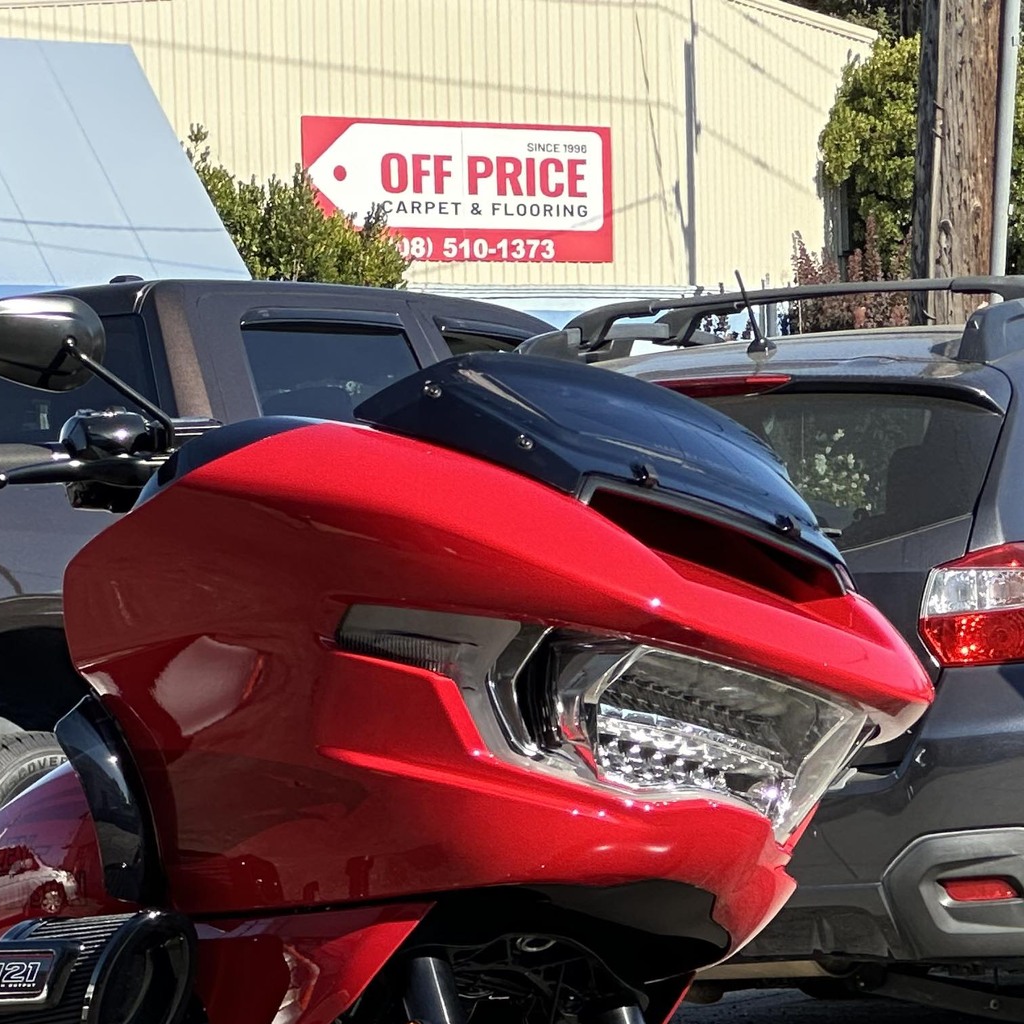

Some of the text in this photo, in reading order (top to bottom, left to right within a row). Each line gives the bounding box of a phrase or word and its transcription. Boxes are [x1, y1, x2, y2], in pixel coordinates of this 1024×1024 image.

[527, 143, 560, 153] SINCE
[380, 152, 588, 198] OFF PRICE
[383, 200, 588, 218] CARPET & FLOORING
[442, 237, 555, 260] 510-1373
